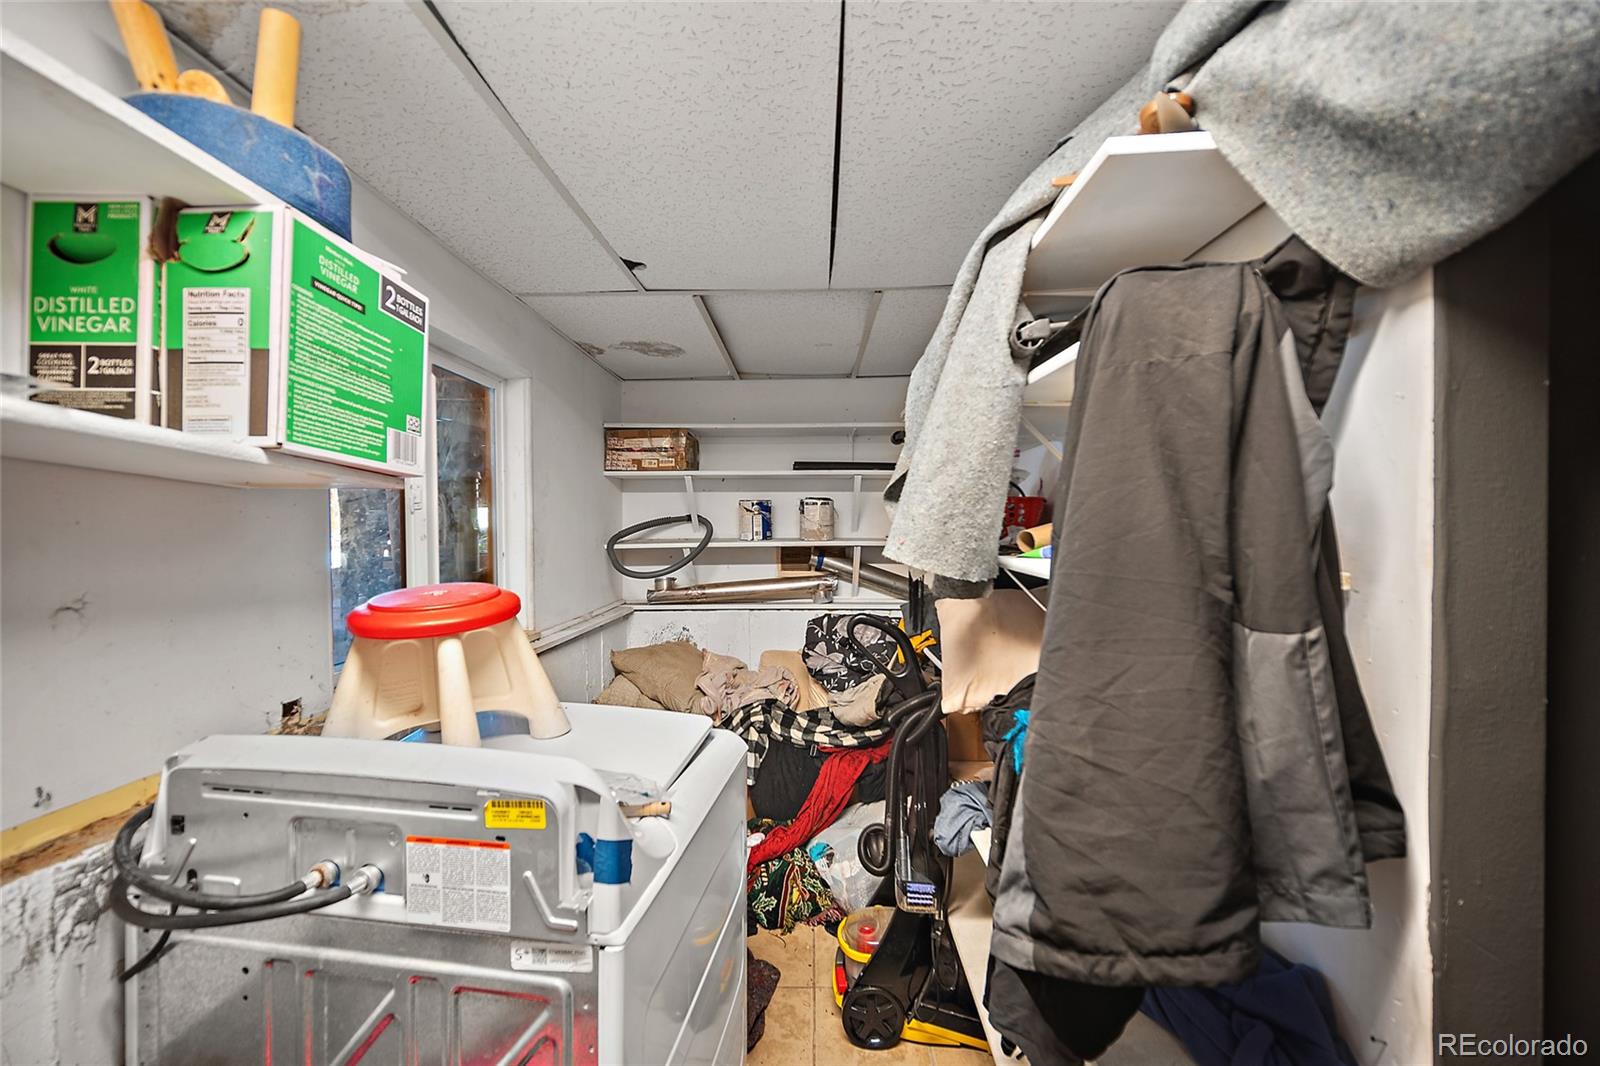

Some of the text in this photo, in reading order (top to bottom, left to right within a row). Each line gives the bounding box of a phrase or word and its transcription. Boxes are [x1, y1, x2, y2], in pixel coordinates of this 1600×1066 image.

[319, 255, 360, 286] DISTILLED
[69, 286, 98, 294] WHITE
[320, 266, 358, 295] VINEGAR
[34, 296, 136, 314] DISTILLED
[384, 285, 423, 316] 2 BOTTLES
[36, 315, 132, 333] VINEGAR
[87, 356, 101, 375] 2
